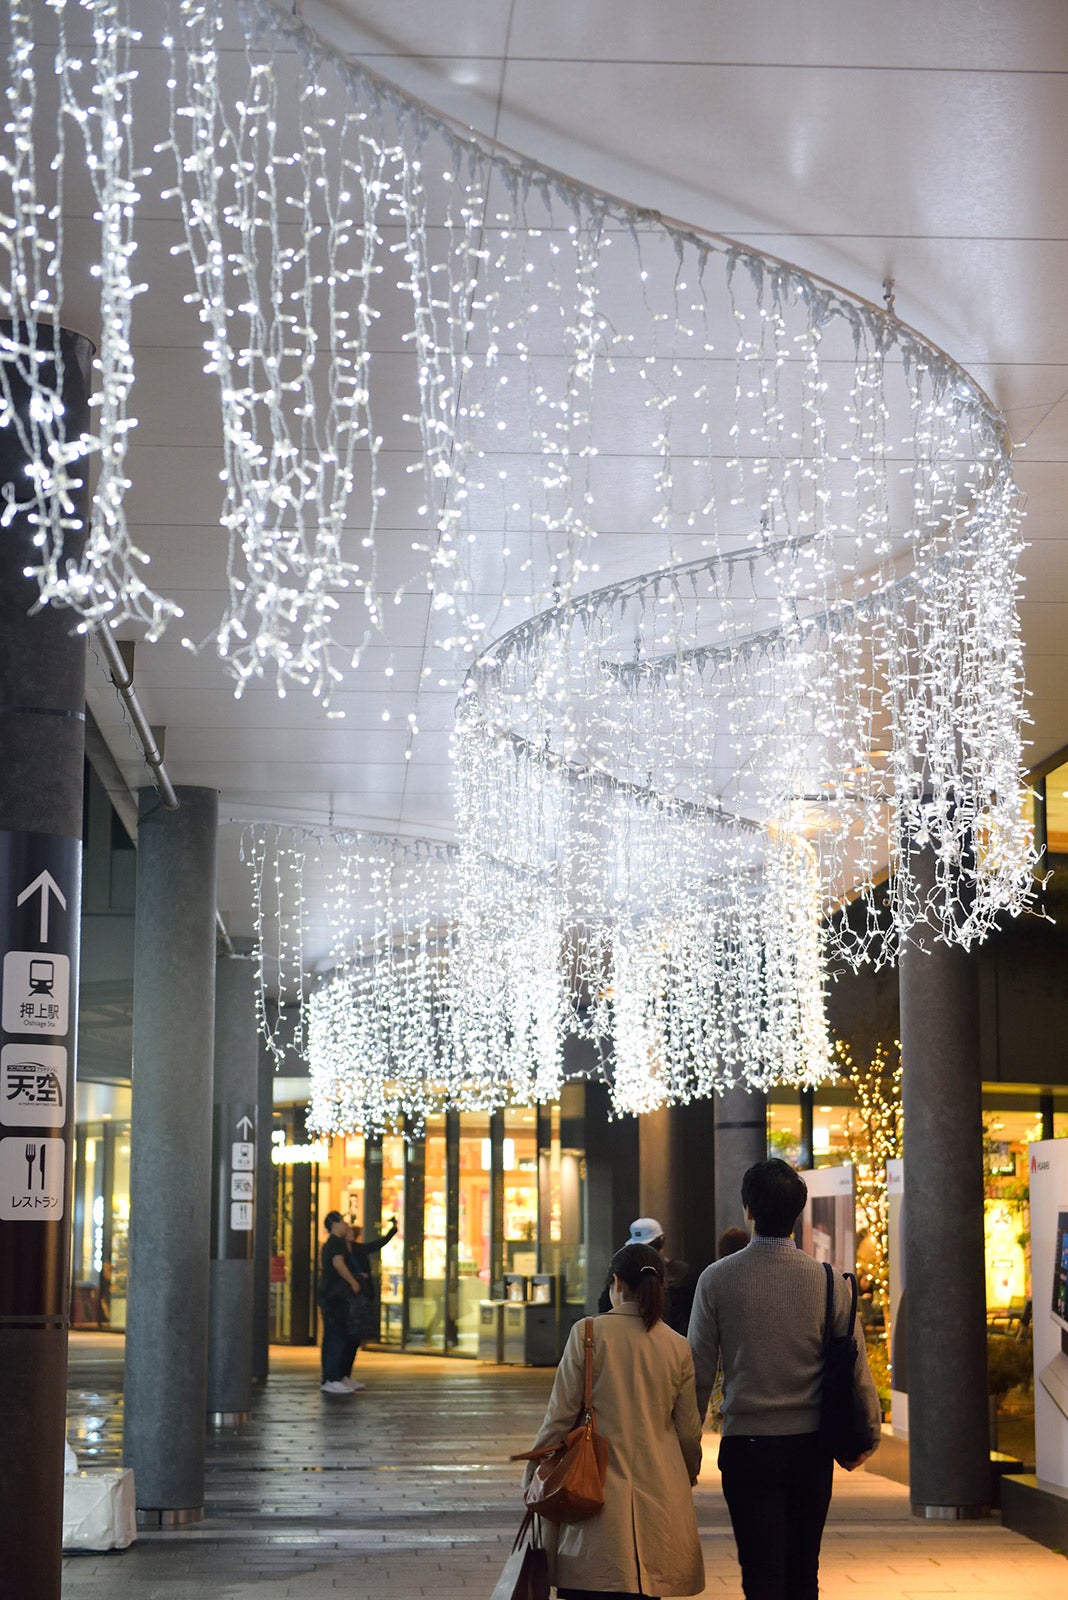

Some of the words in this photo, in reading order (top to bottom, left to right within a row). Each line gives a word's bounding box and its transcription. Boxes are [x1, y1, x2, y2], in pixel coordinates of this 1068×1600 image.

[20, 1002, 60, 1020] 押上駅
[6, 1073, 61, 1103] 天空
[12, 1195, 58, 1208] レストラン
